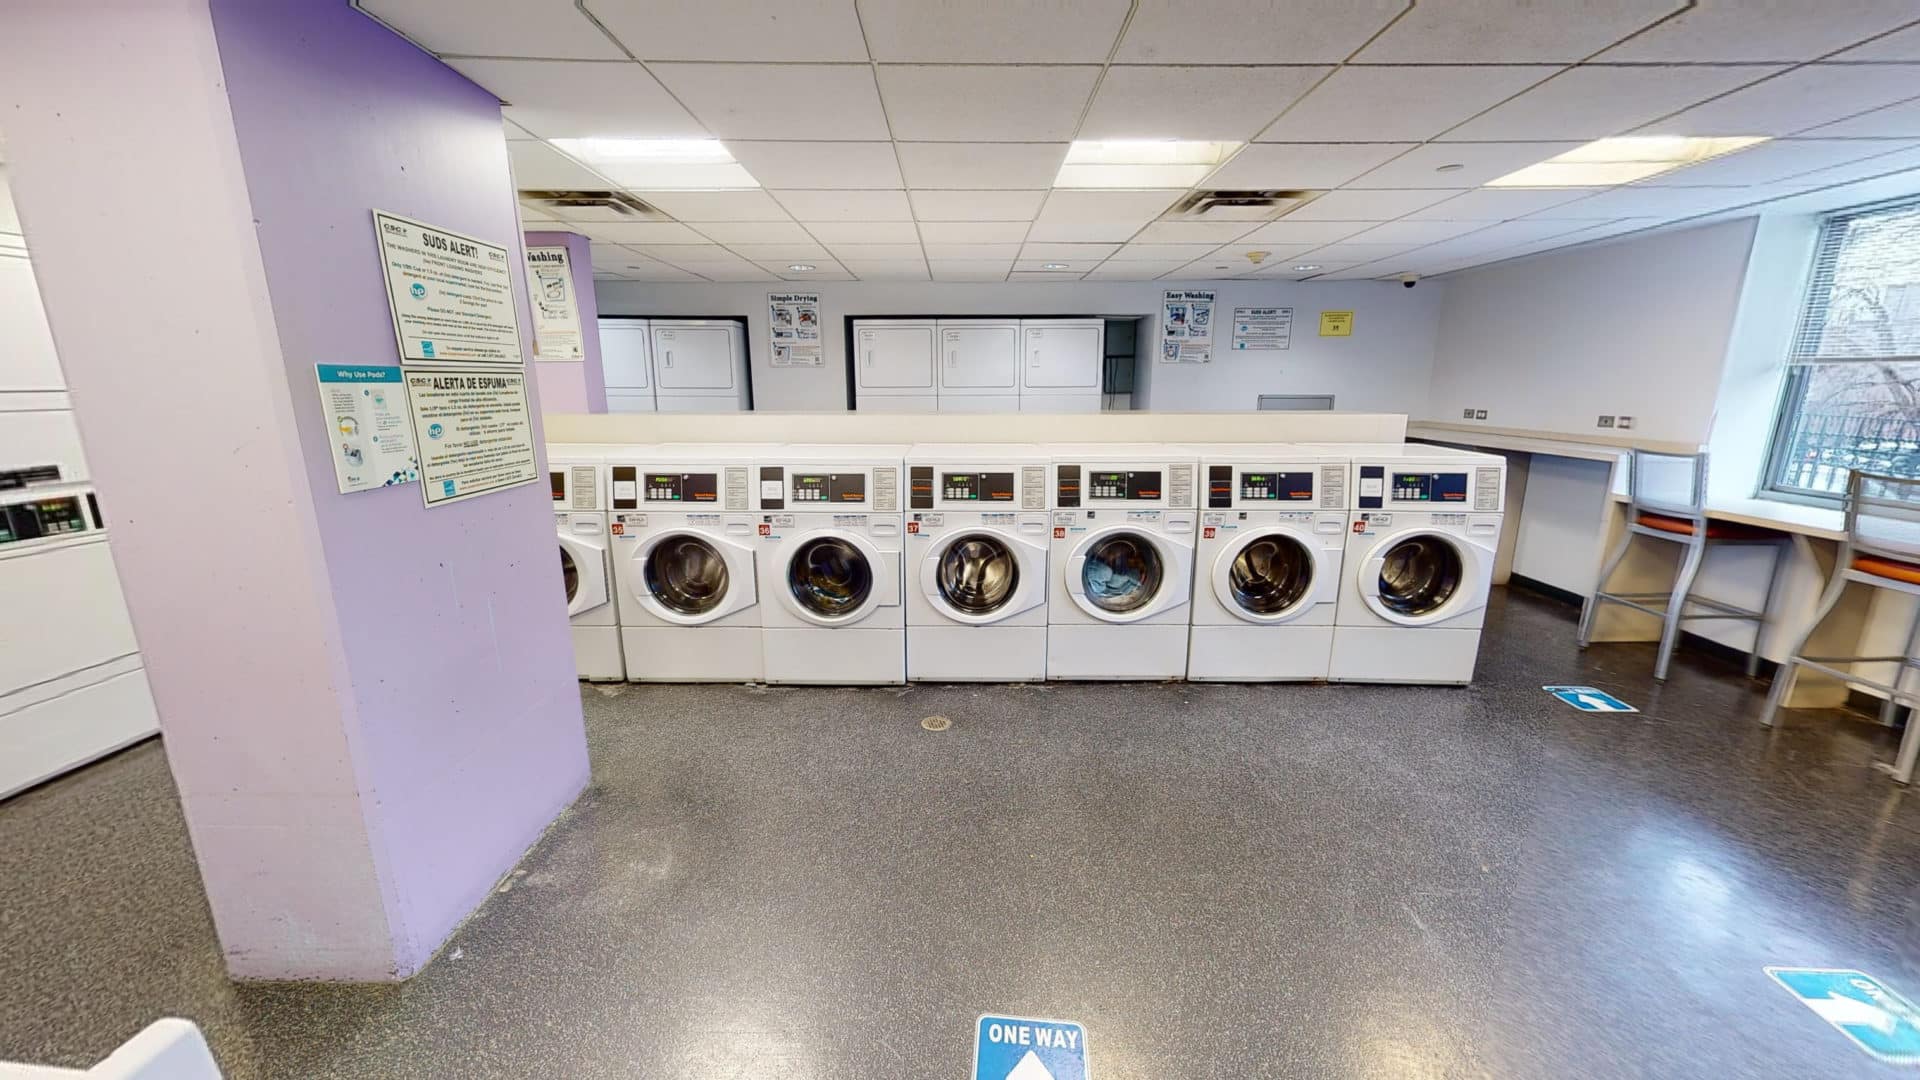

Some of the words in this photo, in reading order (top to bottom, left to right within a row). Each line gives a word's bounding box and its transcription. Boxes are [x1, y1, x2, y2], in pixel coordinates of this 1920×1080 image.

[422, 232, 448, 252] SUDS
[449, 239, 480, 260] ALERT!
[770, 295, 792, 303] Simple
[793, 295, 818, 303] Drying
[1166, 291, 1183, 301] Easy
[1184, 291, 1214, 300] Washing
[336, 370, 353, 379] Why
[353, 370, 366, 378] Use
[366, 370, 386, 378] Pods?
[433, 377, 465, 390] ALERTA
[467, 377, 478, 389] DE
[478, 377, 507, 389] ESPUMA
[612, 526, 623, 534] 35
[908, 525, 918, 533] 37
[1353, 523, 1364, 532] 40
[1054, 530, 1065, 538] 38
[989, 1023, 1031, 1045] ONE
[1035, 1028, 1080, 1050] WAY
